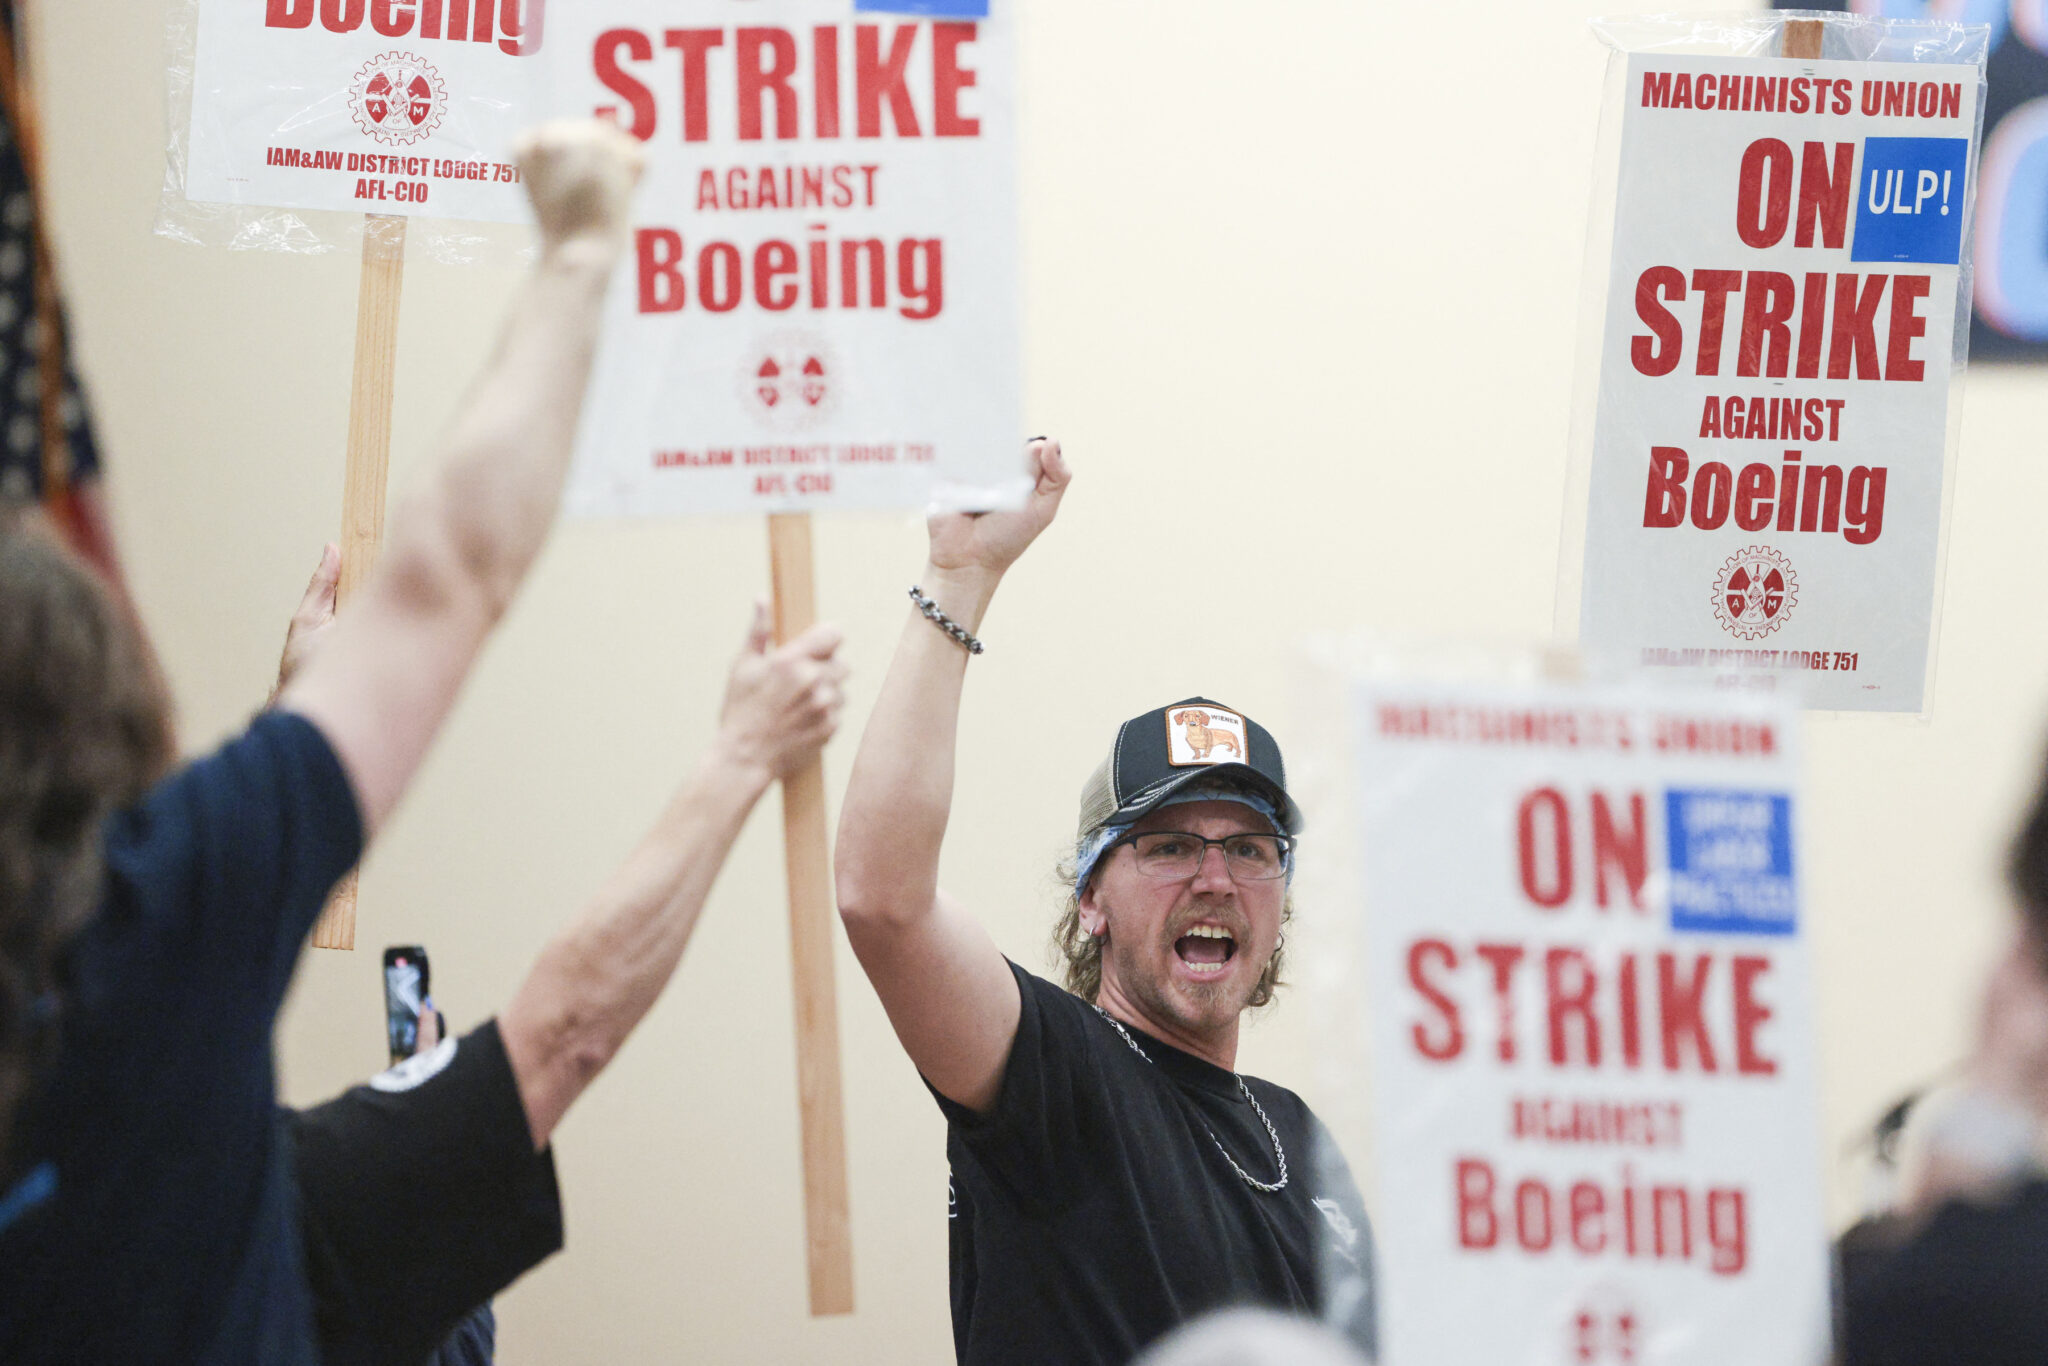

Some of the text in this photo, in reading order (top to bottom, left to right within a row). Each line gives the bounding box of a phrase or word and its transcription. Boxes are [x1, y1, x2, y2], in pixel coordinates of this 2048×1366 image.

[591, 20, 981, 143] STRIKE
[1641, 71, 1962, 119] MACHINISTS UNION
[266, 147, 521, 184] IAM&AW DISTRICT LODGE 751
[354, 178, 429, 204] AFL-CIO
[696, 165, 880, 211] AGAINST
[1736, 137, 1855, 249] ON
[1868, 169, 1952, 216] ULP!
[633, 223, 944, 321] Boeing
[1630, 265, 1931, 382] STRIKE
[1699, 395, 1846, 442] AGAINST
[1642, 446, 1888, 545] Boeing
[1782, 651, 1830, 670] LODGE
[1833, 652, 1859, 671] 751
[1210, 714, 1239, 725] WIENER
[1516, 784, 1650, 912] ON
[1405, 936, 1780, 1078] STRIKE
[1452, 1155, 1750, 1278] Boeing
